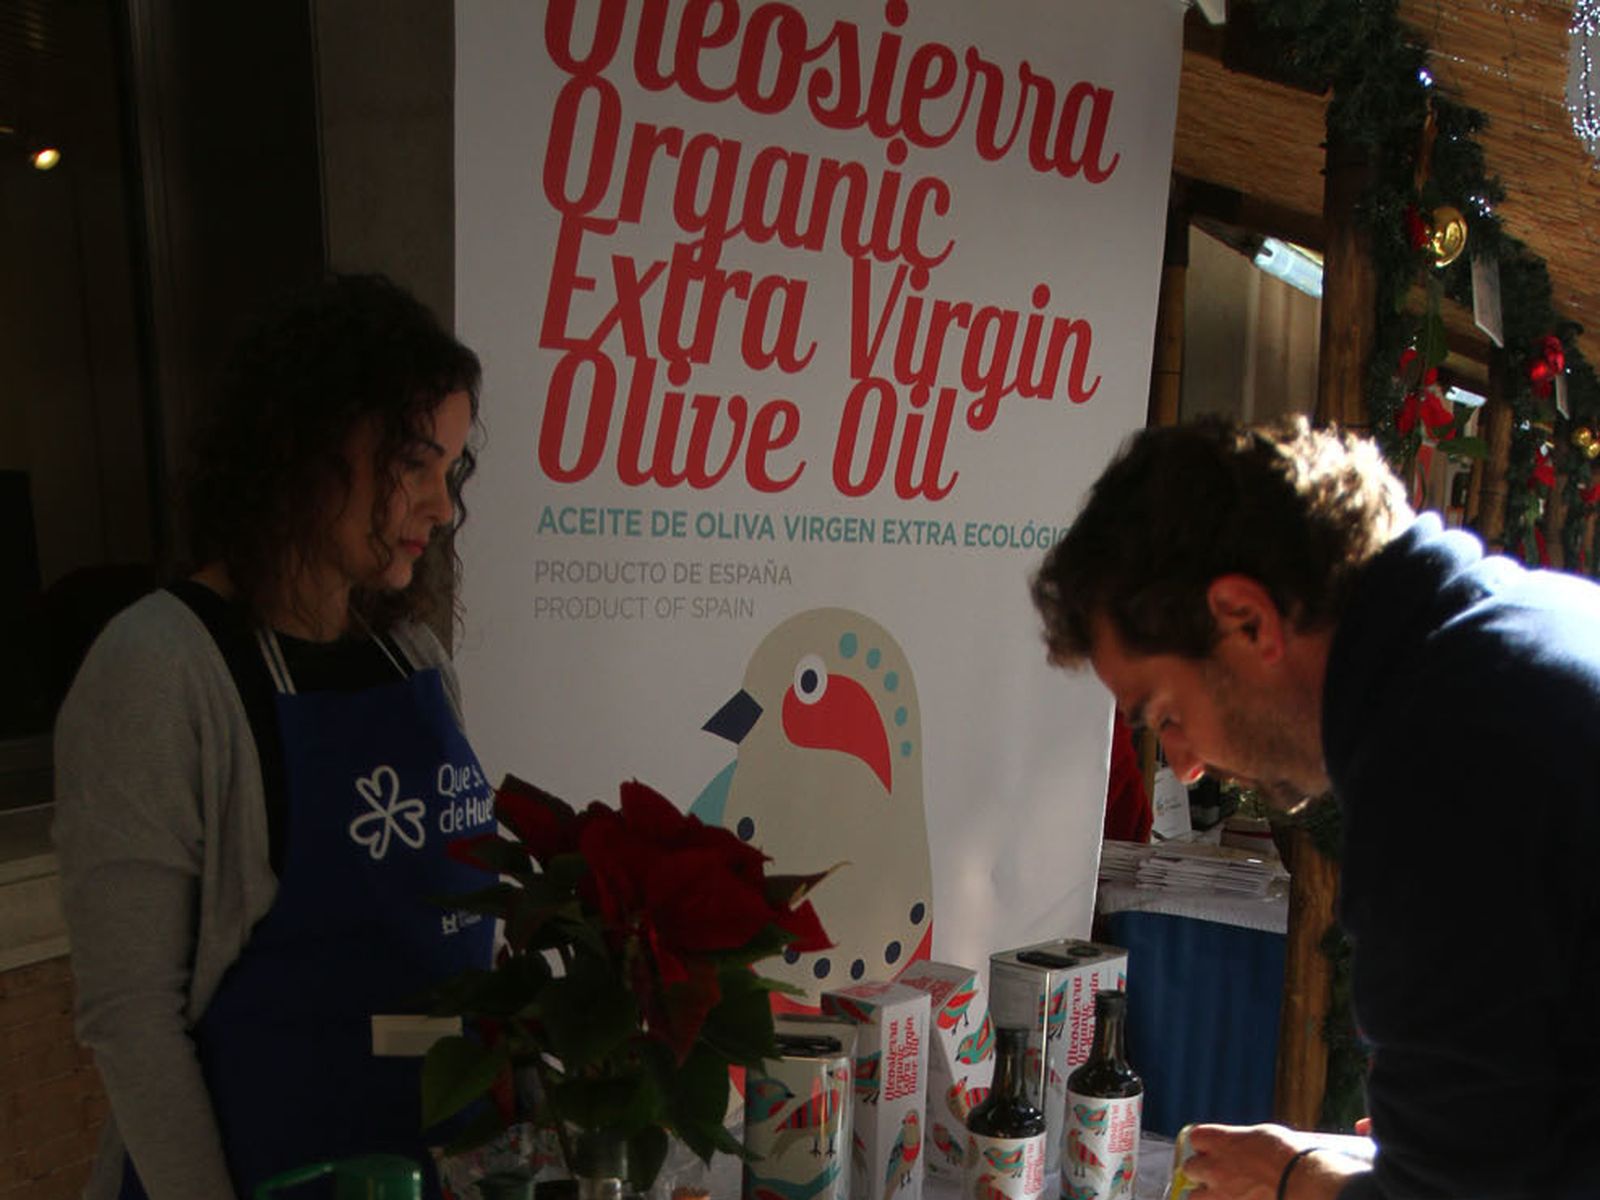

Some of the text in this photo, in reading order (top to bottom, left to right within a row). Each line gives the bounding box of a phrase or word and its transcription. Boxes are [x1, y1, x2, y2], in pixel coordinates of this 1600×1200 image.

[542, 74, 956, 278] Organic
[539, 212, 1101, 432] Extra Virgin
[537, 349, 959, 501] Olive Oil
[534, 558, 793, 586] PRODUCTO DE ESPAÑA
[537, 506, 643, 536] ACEITE
[651, 509, 688, 538] DE
[695, 511, 776, 541] OLIVA
[783, 515, 876, 544] VIRGEN
[882, 518, 957, 547] EXTRA
[533, 596, 754, 620] PRODUCT OF SPAIN
